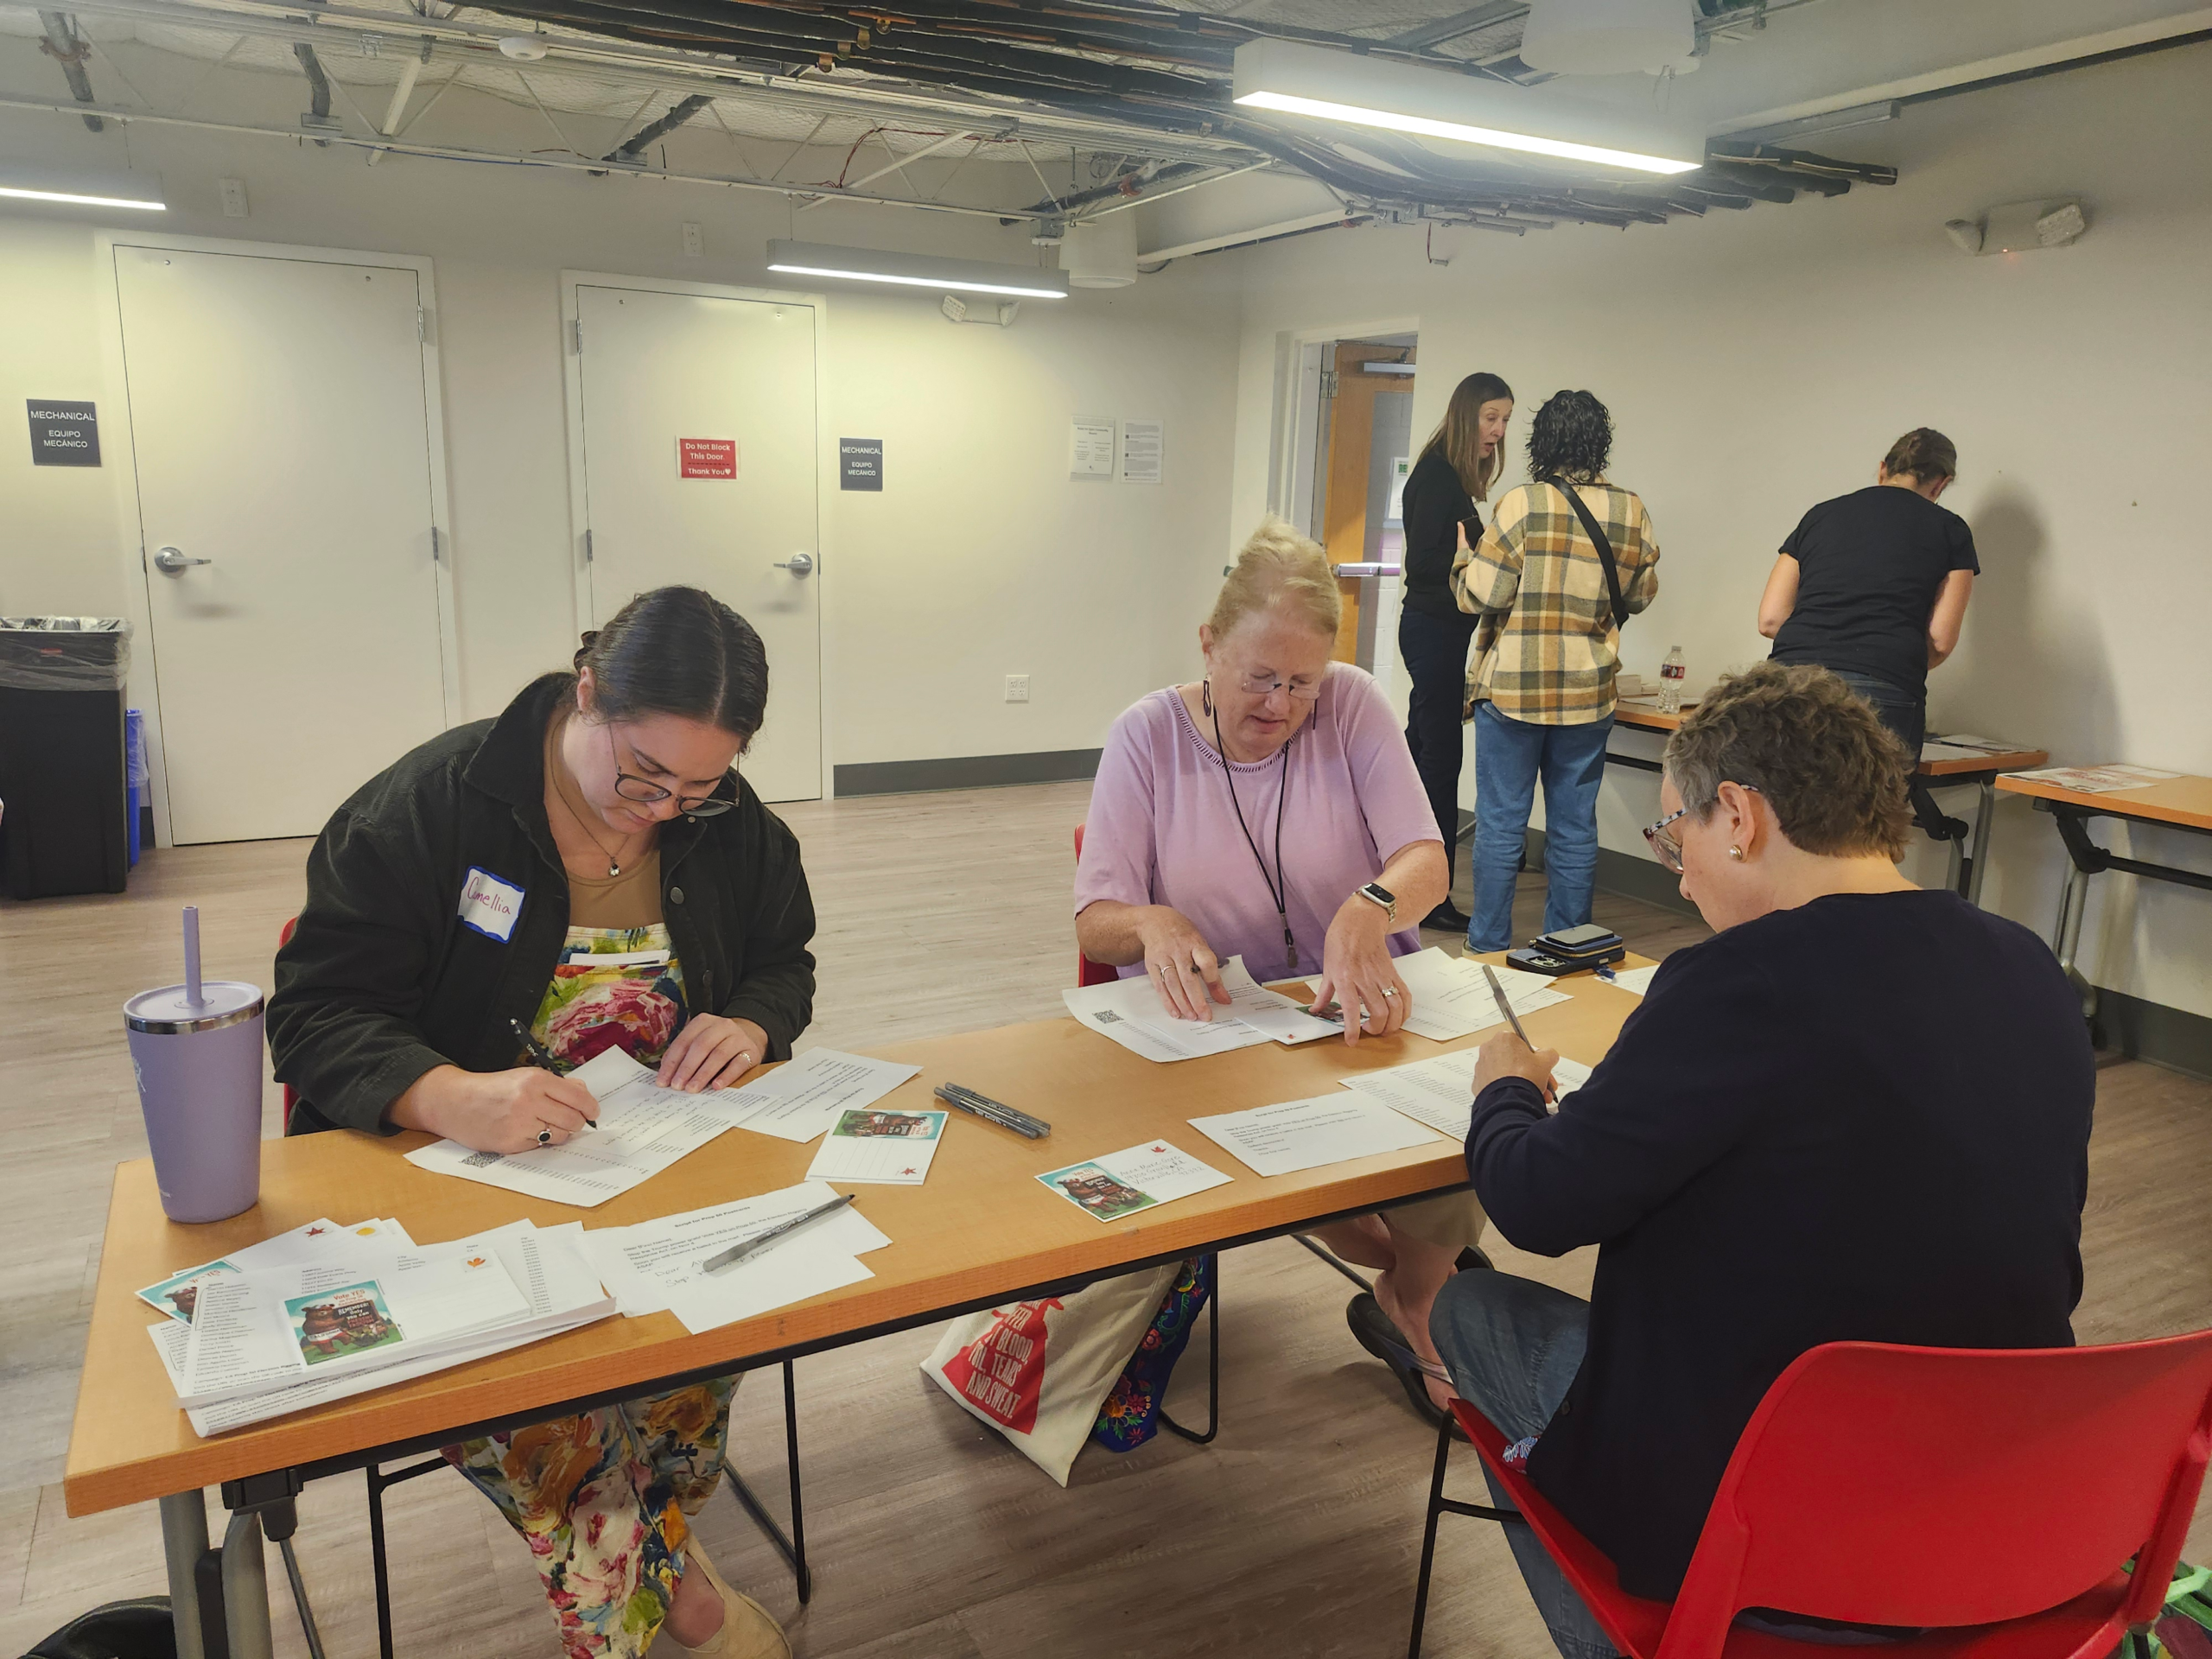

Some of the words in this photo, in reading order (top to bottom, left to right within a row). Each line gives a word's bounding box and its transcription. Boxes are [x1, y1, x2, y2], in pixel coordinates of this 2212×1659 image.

[30, 410, 95, 421] MECHANICAL
[48, 429, 81, 438] EQUIPO
[43, 439, 88, 448] MECÁNICO
[841, 446, 882, 454] MECHANICAL
[723, 1205, 751, 1216] Postcards
[654, 1266, 681, 1277] Dear
[350, 1288, 365, 1297] YES
[1005, 1306, 1033, 1332] FFER
[996, 1328, 1034, 1365] BLOOD,
[991, 1352, 1023, 1388] TEARS
[965, 1370, 992, 1401] AND
[985, 1381, 1022, 1419] SWEAT.
